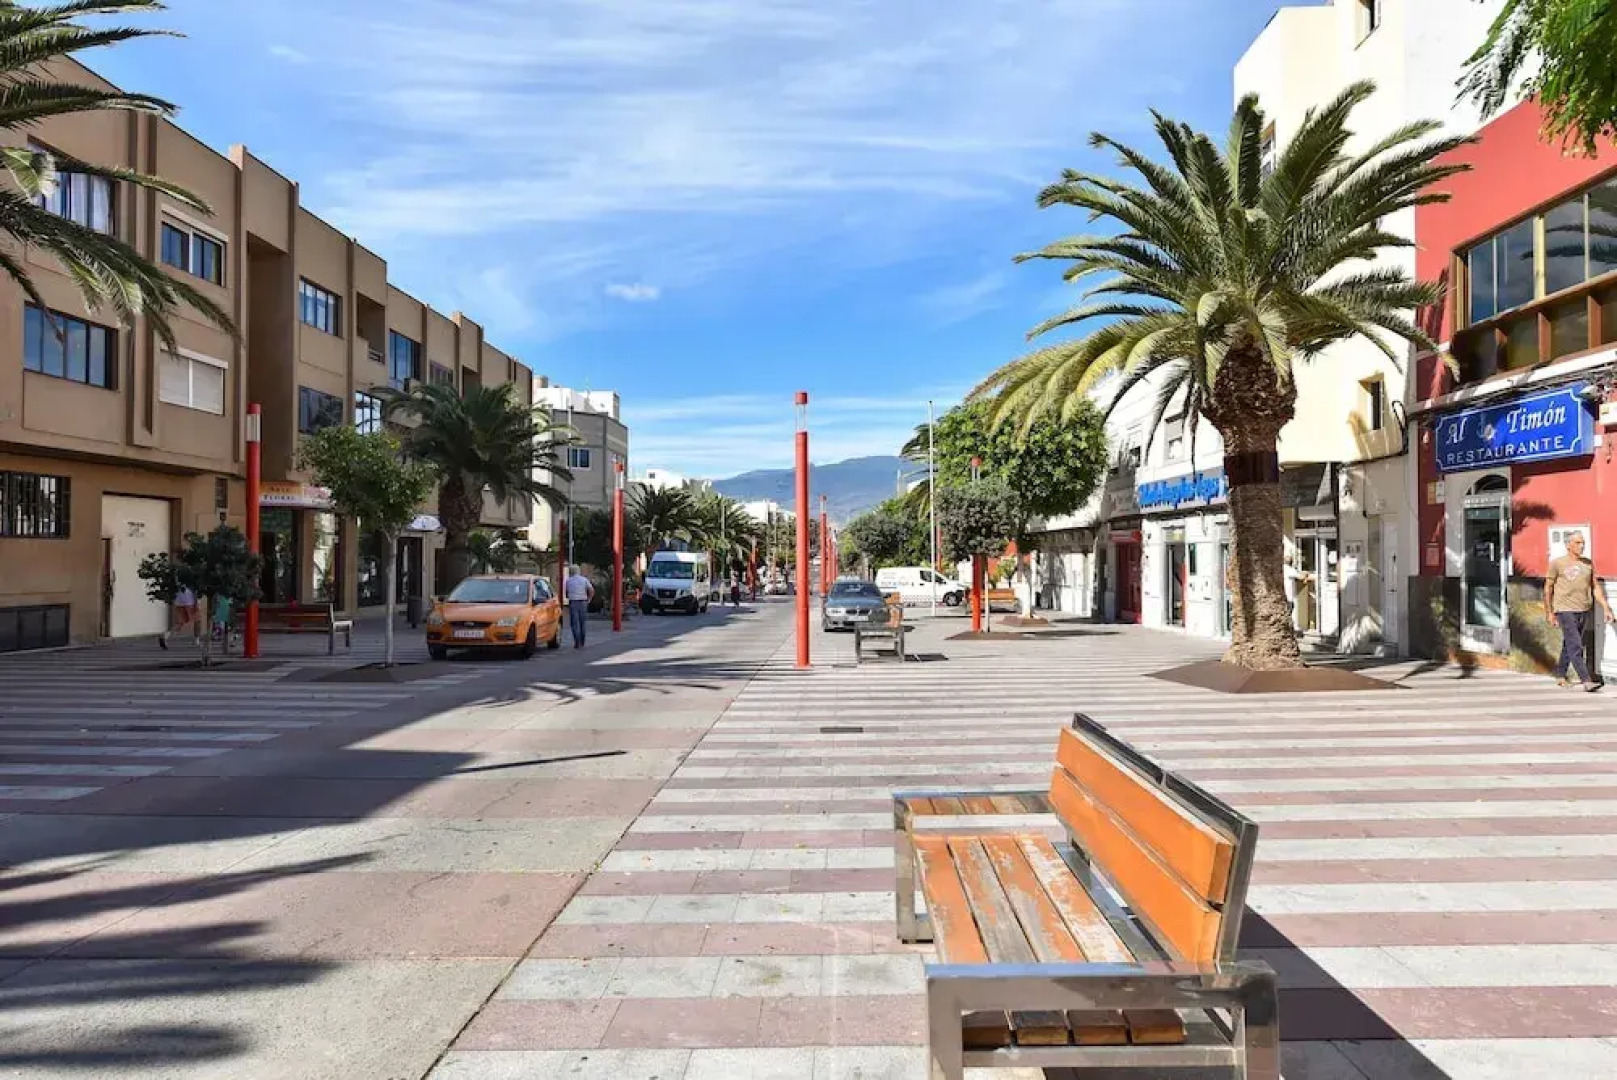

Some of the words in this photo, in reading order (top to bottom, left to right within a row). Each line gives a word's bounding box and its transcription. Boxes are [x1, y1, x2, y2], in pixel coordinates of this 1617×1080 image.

[1445, 416, 1468, 444] Al
[1506, 401, 1566, 433] Timón
[1446, 436, 1565, 464] RESTAURANTE
